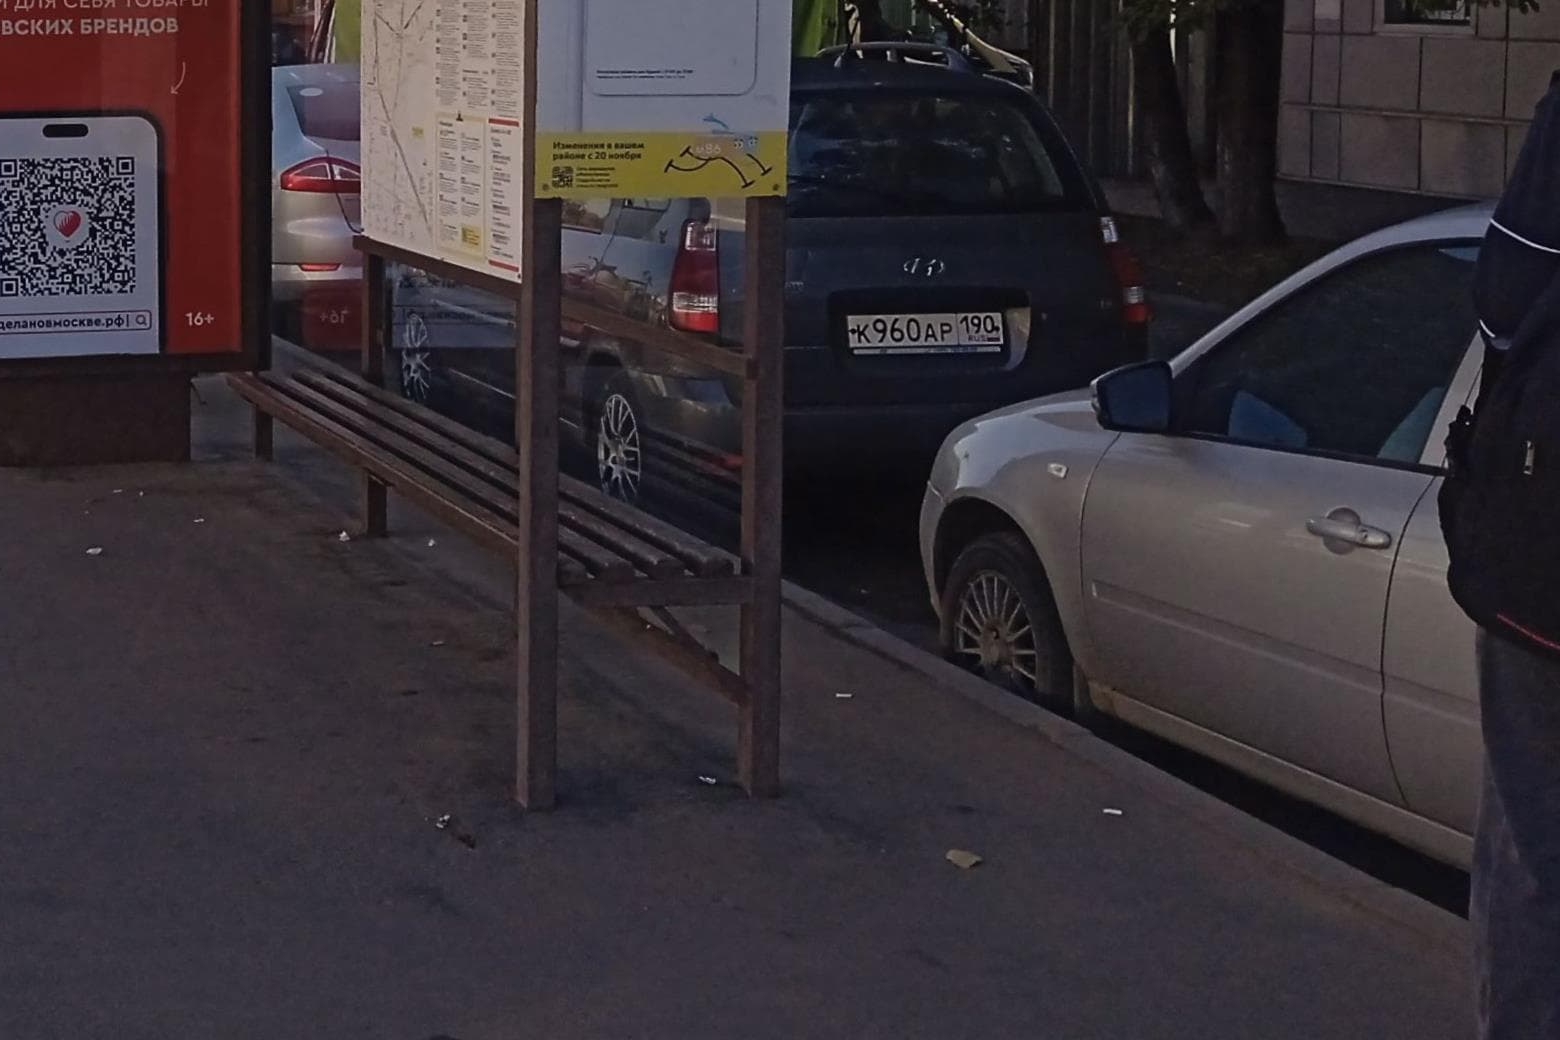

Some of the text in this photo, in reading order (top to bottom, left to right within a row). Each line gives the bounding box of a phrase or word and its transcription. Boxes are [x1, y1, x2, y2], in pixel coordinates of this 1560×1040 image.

[80, 17, 179, 37] БРЕНДОВ
[553, 151, 586, 160] районе
[594, 151, 607, 160] 20
[608, 151, 642, 161] ноября
[185, 312, 214, 326] 16+
[856, 315, 995, 344] К960АР 190
